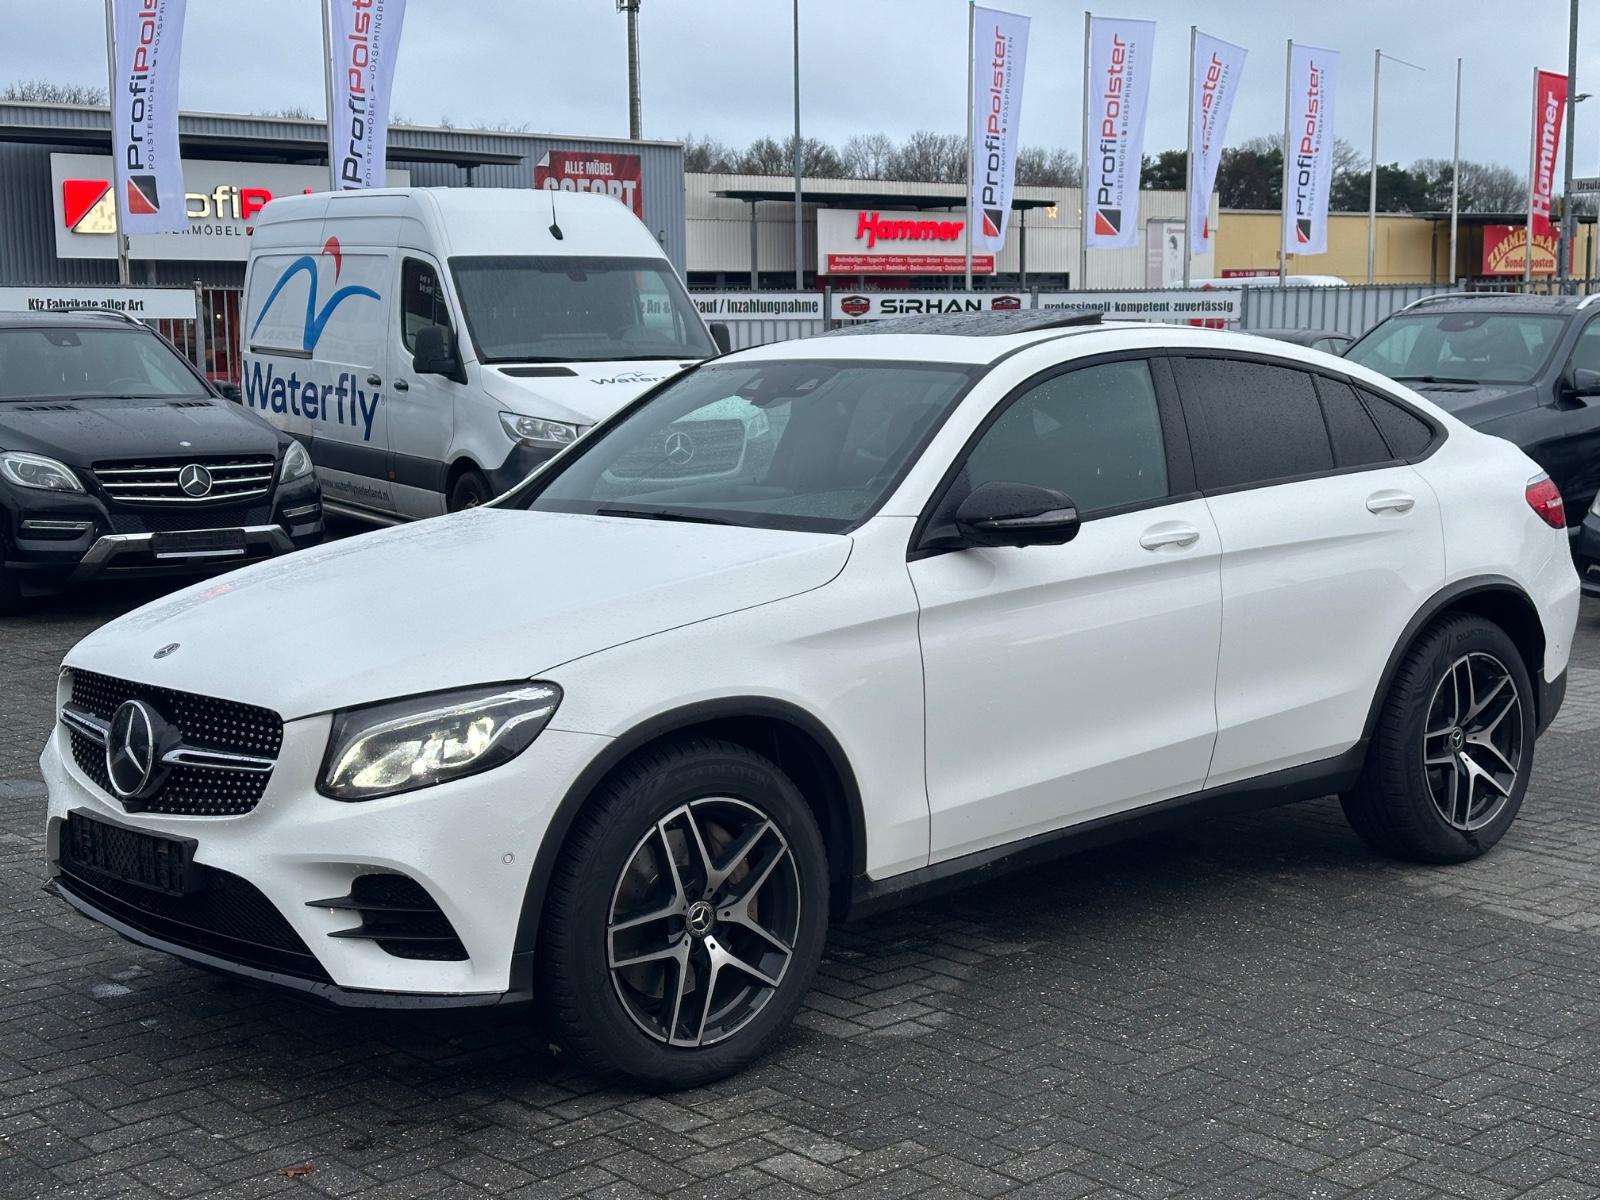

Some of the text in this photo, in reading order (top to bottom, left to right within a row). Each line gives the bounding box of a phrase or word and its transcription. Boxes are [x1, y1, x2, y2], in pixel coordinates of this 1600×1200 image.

[983, 25, 1006, 205] ProfiPolster
[1097, 33, 1126, 206] ProfiPolster
[1116, 42, 1135, 206] POLSTERMÖBEL BOXSPRINGBETTEN
[1296, 60, 1319, 215] ProfiPolster
[1532, 91, 1559, 218] Hammer
[565, 159, 614, 175] ALLE MÖBEL
[856, 210, 964, 248] Hammer
[28, 298, 144, 311] Kfz Fabrikate aller Art
[694, 299, 719, 314] kauf
[727, 299, 819, 315] Inzahlungnahme
[1114, 301, 1170, 313] kompetent
[1173, 300, 1234, 313] zuverlässig
[243, 360, 380, 441] Waterfly
